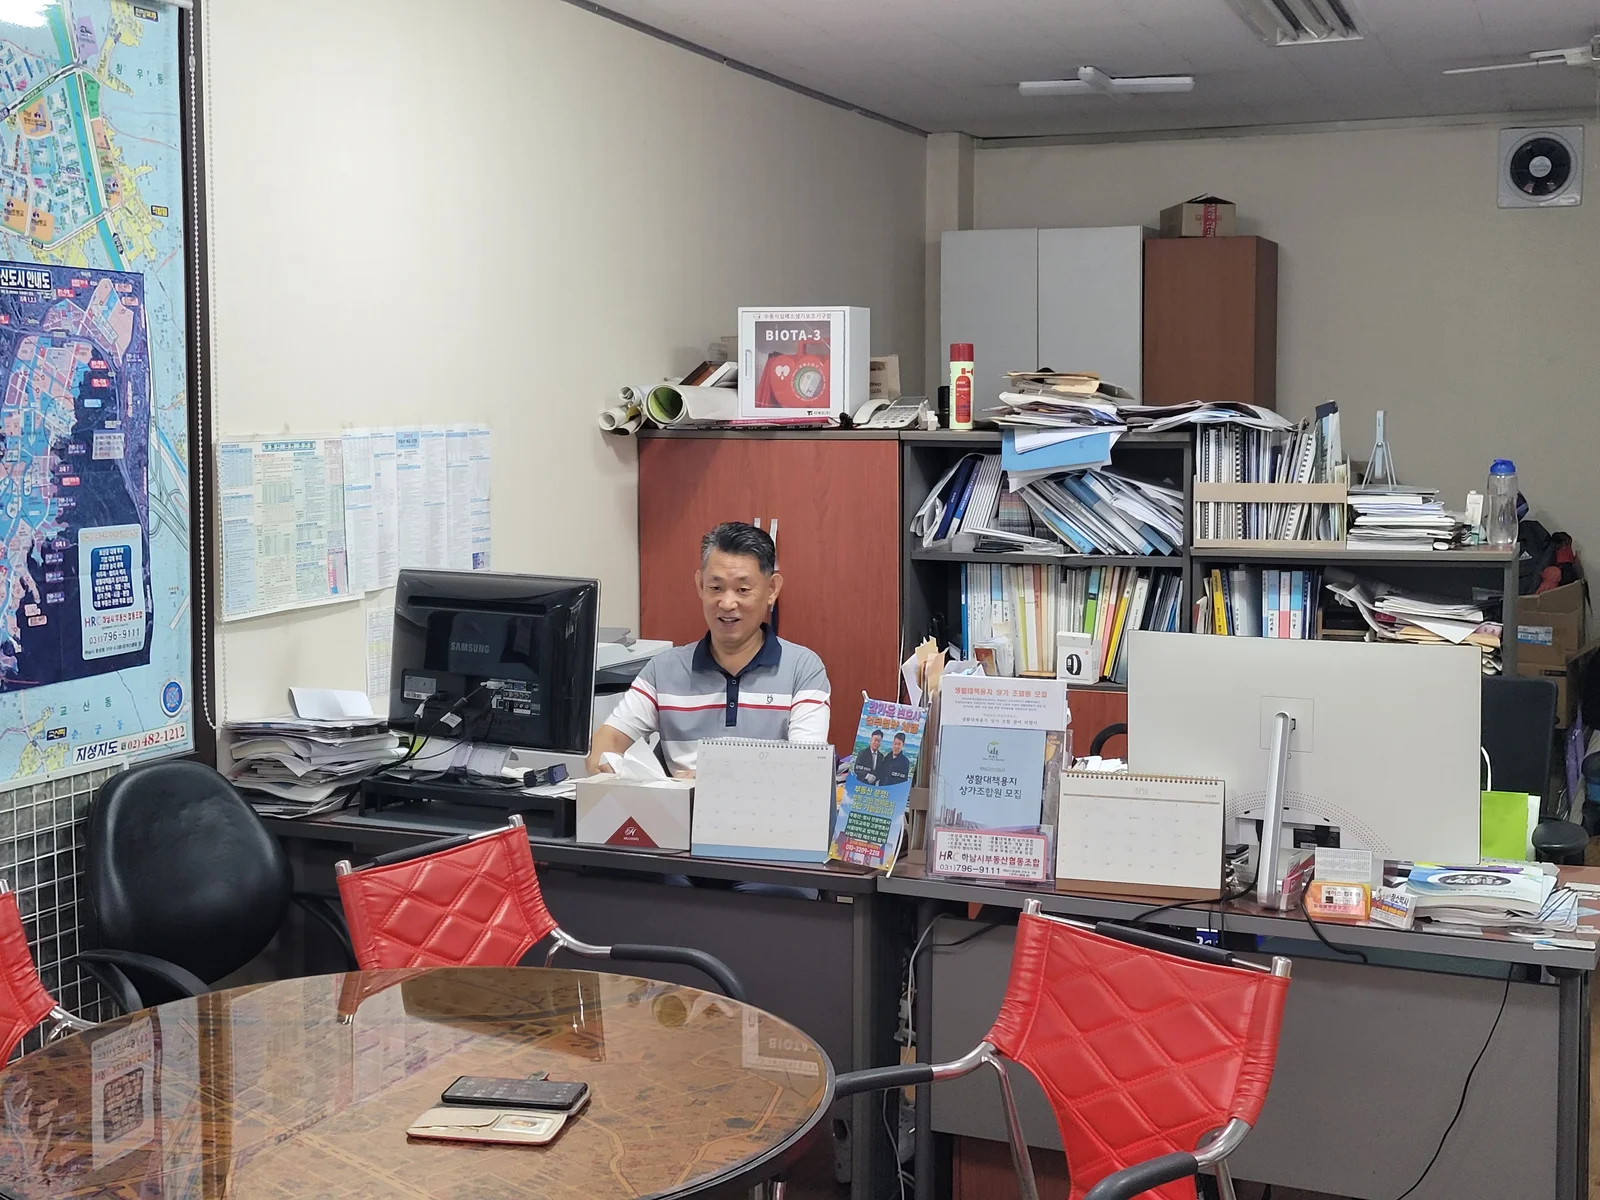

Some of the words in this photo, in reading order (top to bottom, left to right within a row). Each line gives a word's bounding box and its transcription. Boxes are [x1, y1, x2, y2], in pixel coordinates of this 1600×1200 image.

[0, 268, 25, 287] 신도시
[26, 271, 50, 289] 안내도
[765, 329, 821, 341] BIOTA-3
[450, 641, 490, 654] SAMSUNG
[954, 687, 993, 696] 생활대책용지
[996, 688, 1009, 696] 상가
[76, 740, 118, 762] 지성지도
[965, 774, 1018, 787] 생활대책용지
[959, 785, 1002, 799] 상가조합원
[1004, 788, 1022, 800] 모집
[961, 852, 1040, 867] 하남시부동산협동조합
[940, 863, 1000, 875] 031)796-9111
